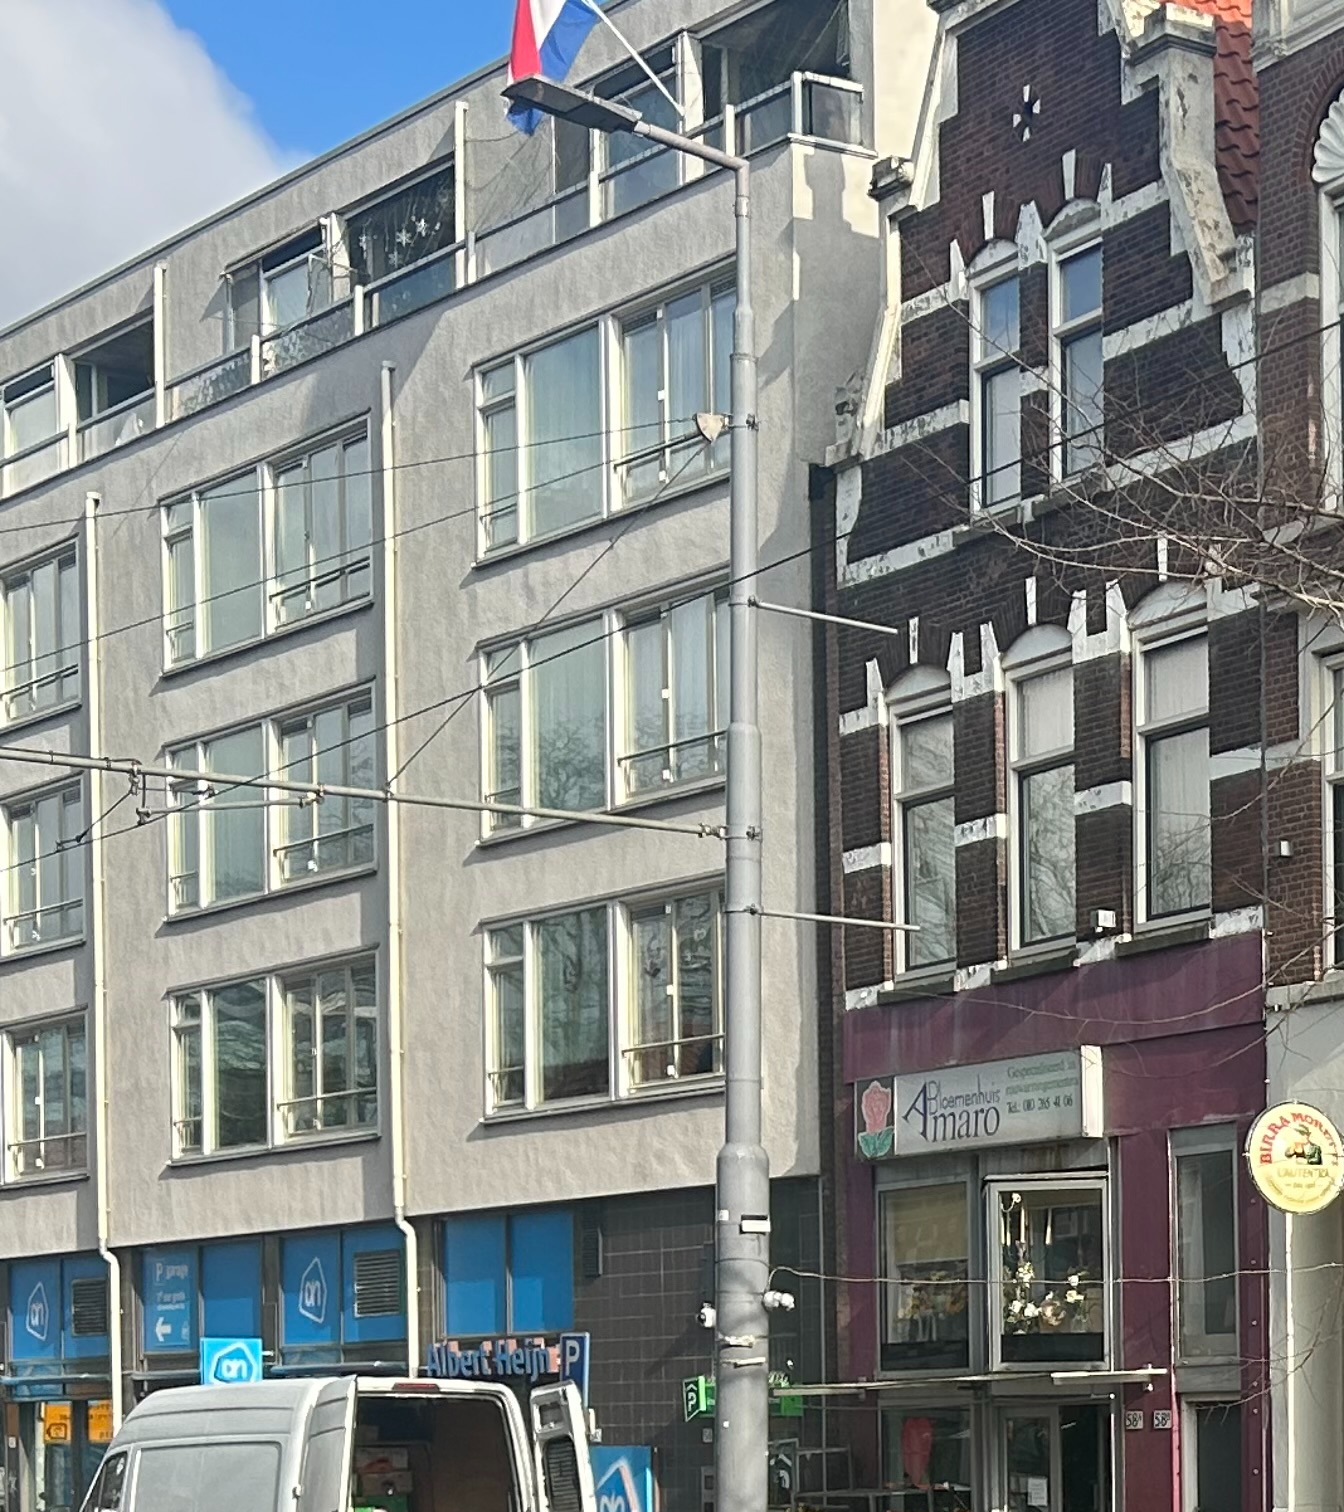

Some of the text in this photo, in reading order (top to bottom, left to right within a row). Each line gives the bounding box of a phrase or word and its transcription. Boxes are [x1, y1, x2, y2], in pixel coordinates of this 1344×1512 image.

[902, 1081, 1001, 1143] Amaro
[926, 1073, 1001, 1116] Bloemenhuis
[1259, 1115, 1290, 1164] BIRRA
[427, 1338, 553, 1383] Albert Heijn
[565, 1339, 580, 1377] P
